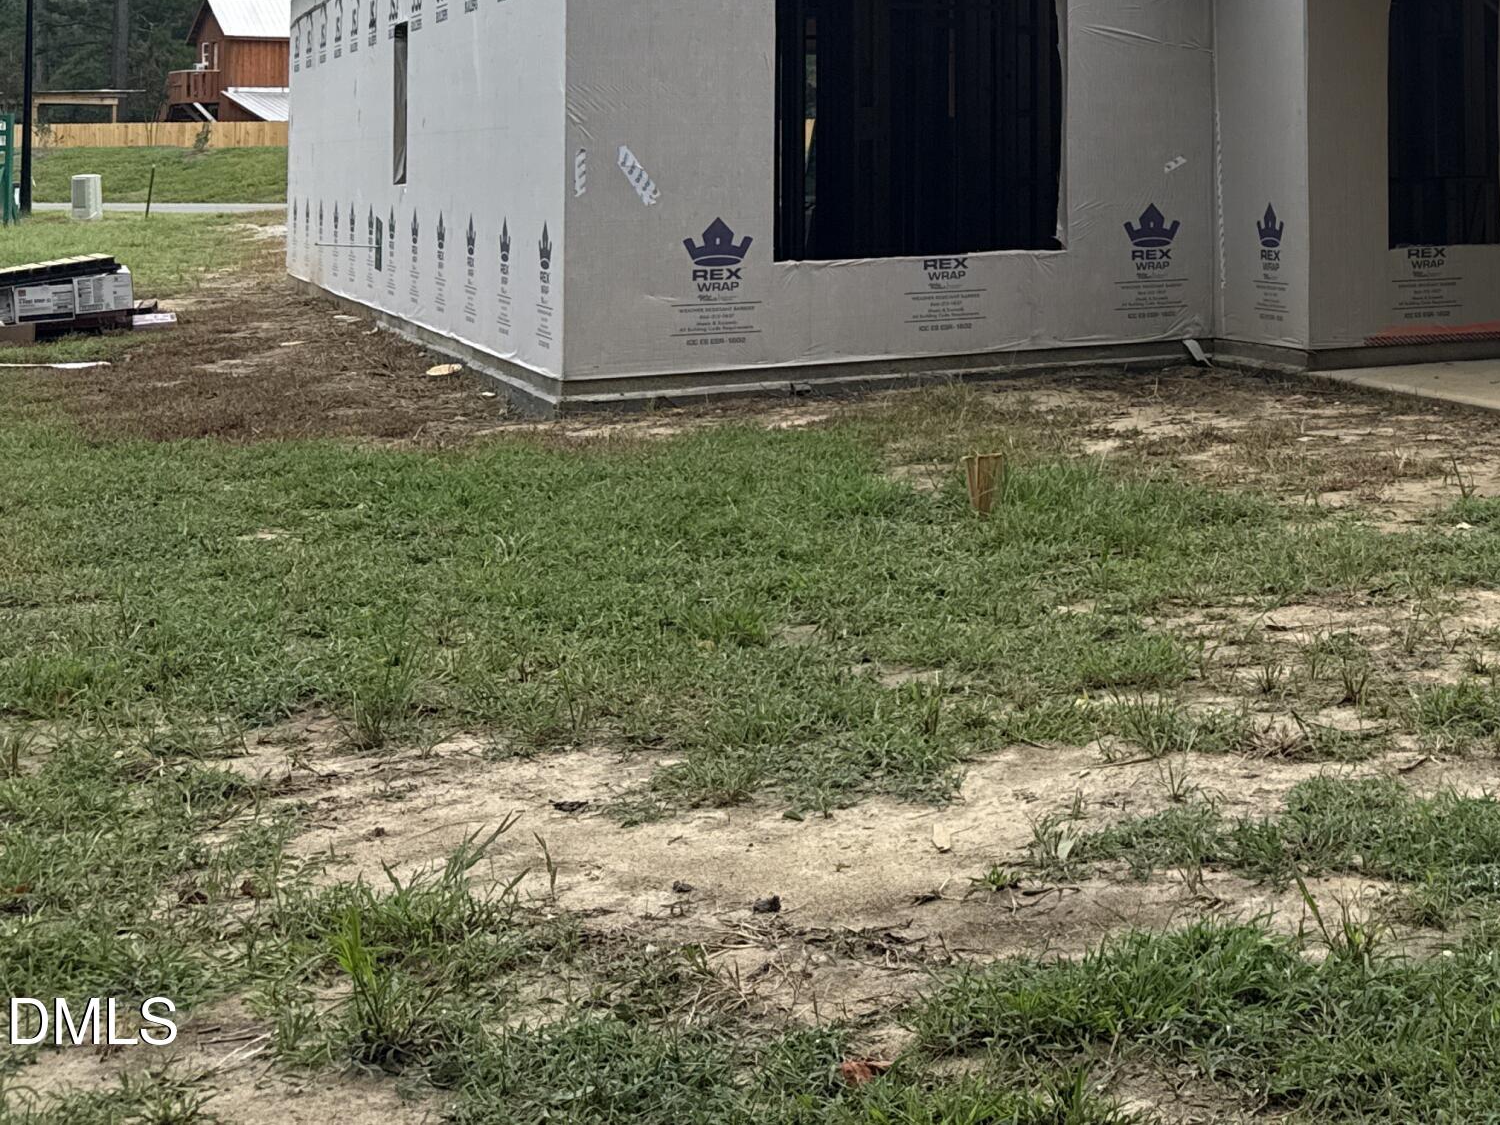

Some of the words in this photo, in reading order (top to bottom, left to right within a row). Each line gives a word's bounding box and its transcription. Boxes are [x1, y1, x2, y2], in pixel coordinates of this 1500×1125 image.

[1131, 249, 1172, 260] REX
[1260, 250, 1280, 261] REX
[1408, 247, 1446, 259] REX
[924, 257, 968, 270] REX
[1135, 262, 1170, 270] WRAP
[1411, 259, 1445, 269] WRAP
[692, 268, 742, 281] REX
[928, 270, 966, 280] WRAP
[697, 281, 739, 292] WRAP
